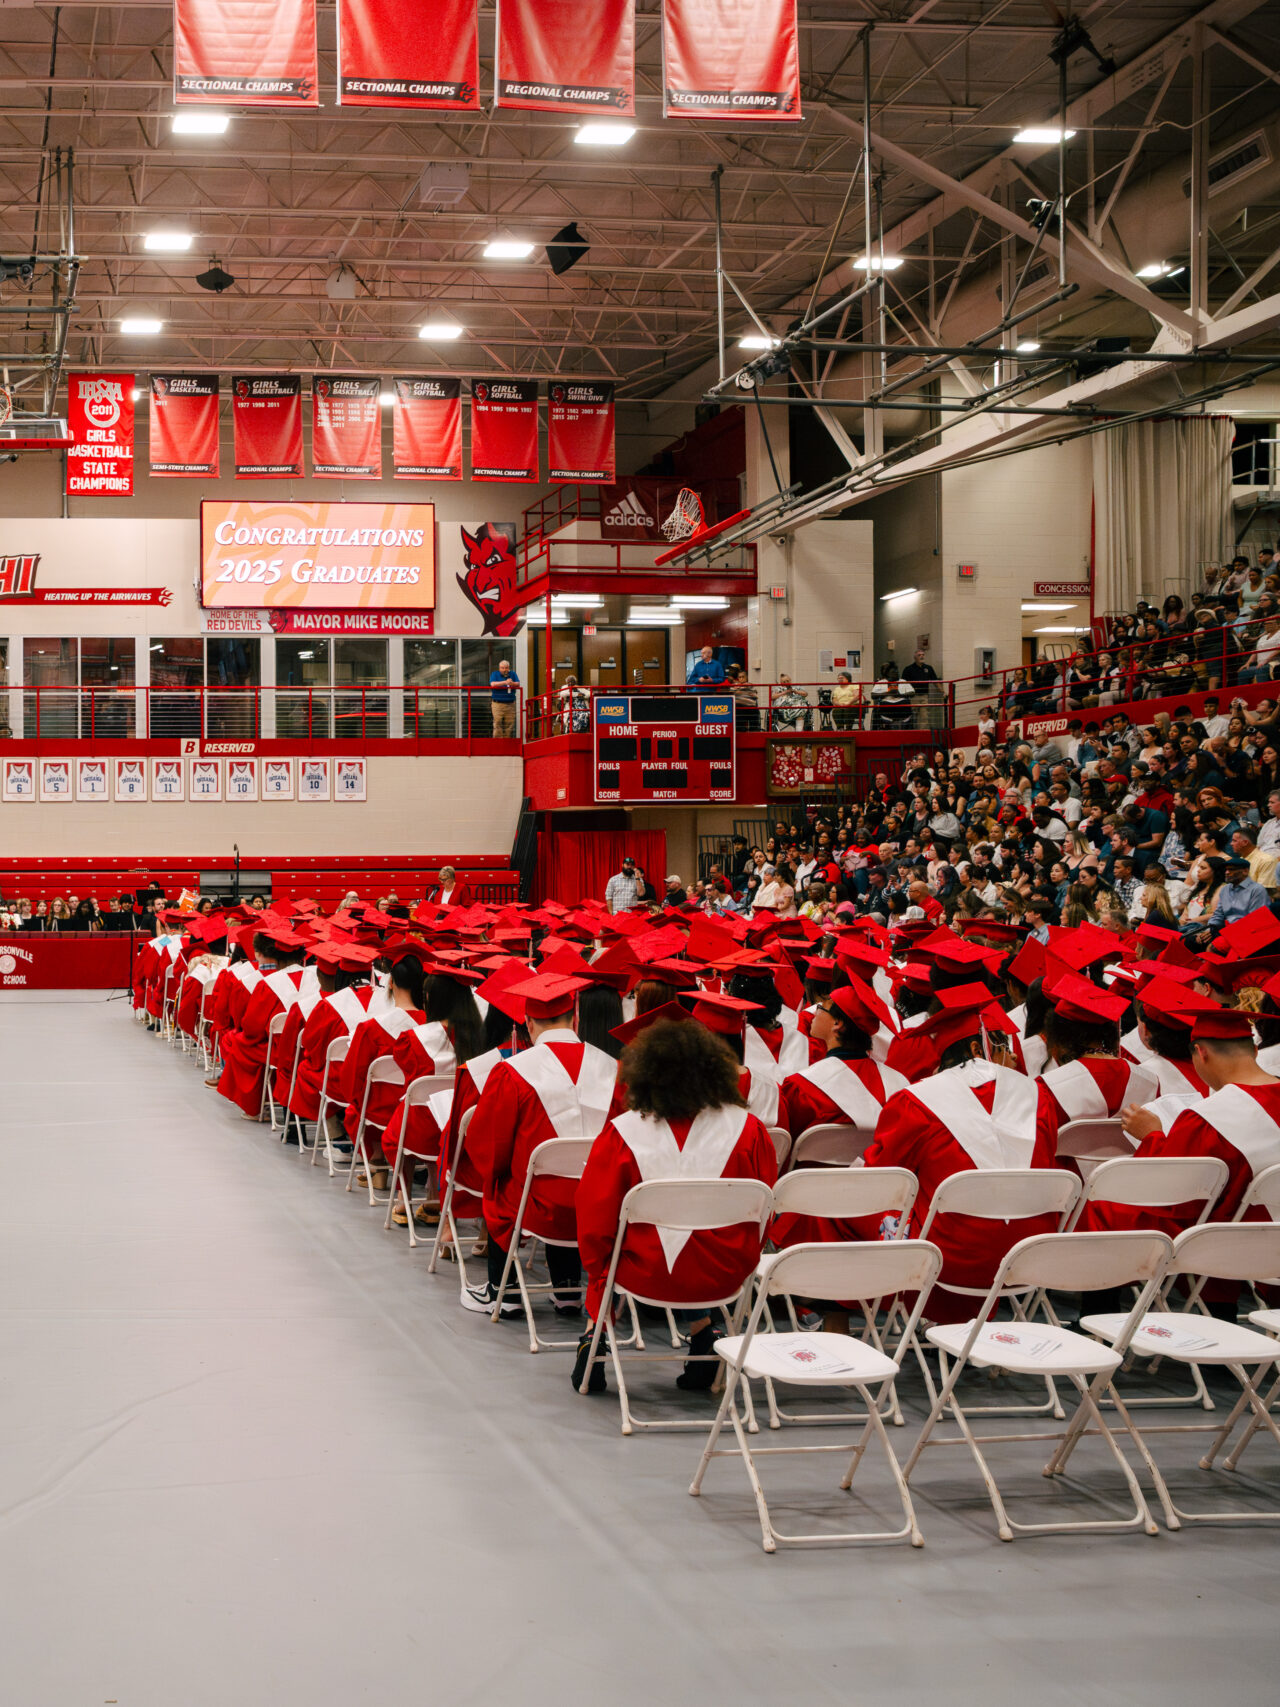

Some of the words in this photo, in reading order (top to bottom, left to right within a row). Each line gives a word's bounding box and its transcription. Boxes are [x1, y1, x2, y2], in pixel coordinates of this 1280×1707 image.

[181, 80, 244, 91] SECTIONAL
[247, 81, 294, 92] CHAMPS
[346, 81, 407, 93] SECTIONAL
[409, 84, 456, 95] CHAMPS
[505, 84, 562, 98] REGIONAL
[563, 89, 610, 100] CHAMPS
[672, 93, 730, 104] SECTIONAL
[732, 95, 777, 106] CHAMPS
[170, 379, 198, 387] GIRLS
[252, 381, 280, 389] GIRLS
[413, 382, 440, 390] GIRLS
[170, 386, 213, 394] BASKETBALL
[413, 389, 446, 397] SOFTBALL
[491, 385, 518, 393] GIRLS
[567, 387, 594, 395] GIRLS
[91, 405, 112, 415] 2011
[86, 429, 116, 442] GIRLS
[68, 445, 133, 458] BASKETBALL
[83, 462, 118, 475] STATE
[474, 468, 503, 476] SECTIONAL
[70, 477, 130, 491] CHAMPIONS
[604, 513, 655, 527] adidas
[214, 521, 425, 547] CONGRATULATIONS
[216, 559, 284, 585] 2025
[291, 559, 421, 584] GRADUATES
[1039, 584, 1091, 593] CONCESSION
[44, 593, 79, 601] HEATING
[81, 593, 92, 601] UP
[93, 593, 108, 601] THE
[110, 593, 152, 601] AIRWAVES
[210, 611, 228, 619] HOME
[230, 611, 240, 619] OF
[242, 611, 258, 619] THE
[207, 619, 225, 631] RED
[228, 619, 262, 631] DEVILS
[293, 615, 342, 629] MAYOR
[344, 615, 377, 629] MIKE
[381, 615, 429, 629] MOORE
[600, 706, 624, 714] NWSB
[704, 705, 729, 713] NWSB
[609, 725, 639, 736] HOME
[695, 724, 728, 735] GUEST
[1026, 718, 1068, 736] RESERVED
[184, 741, 195, 754] B
[204, 743, 255, 753] RESERVED
[16, 784, 22, 793] 6
[164, 784, 172, 793] 11
[309, 781, 319, 789] 10
[345, 780, 354, 789] 14
[598, 791, 620, 799] SCORE
[710, 790, 731, 798] SCORE
[3, 975, 27, 985] SCHOOL
